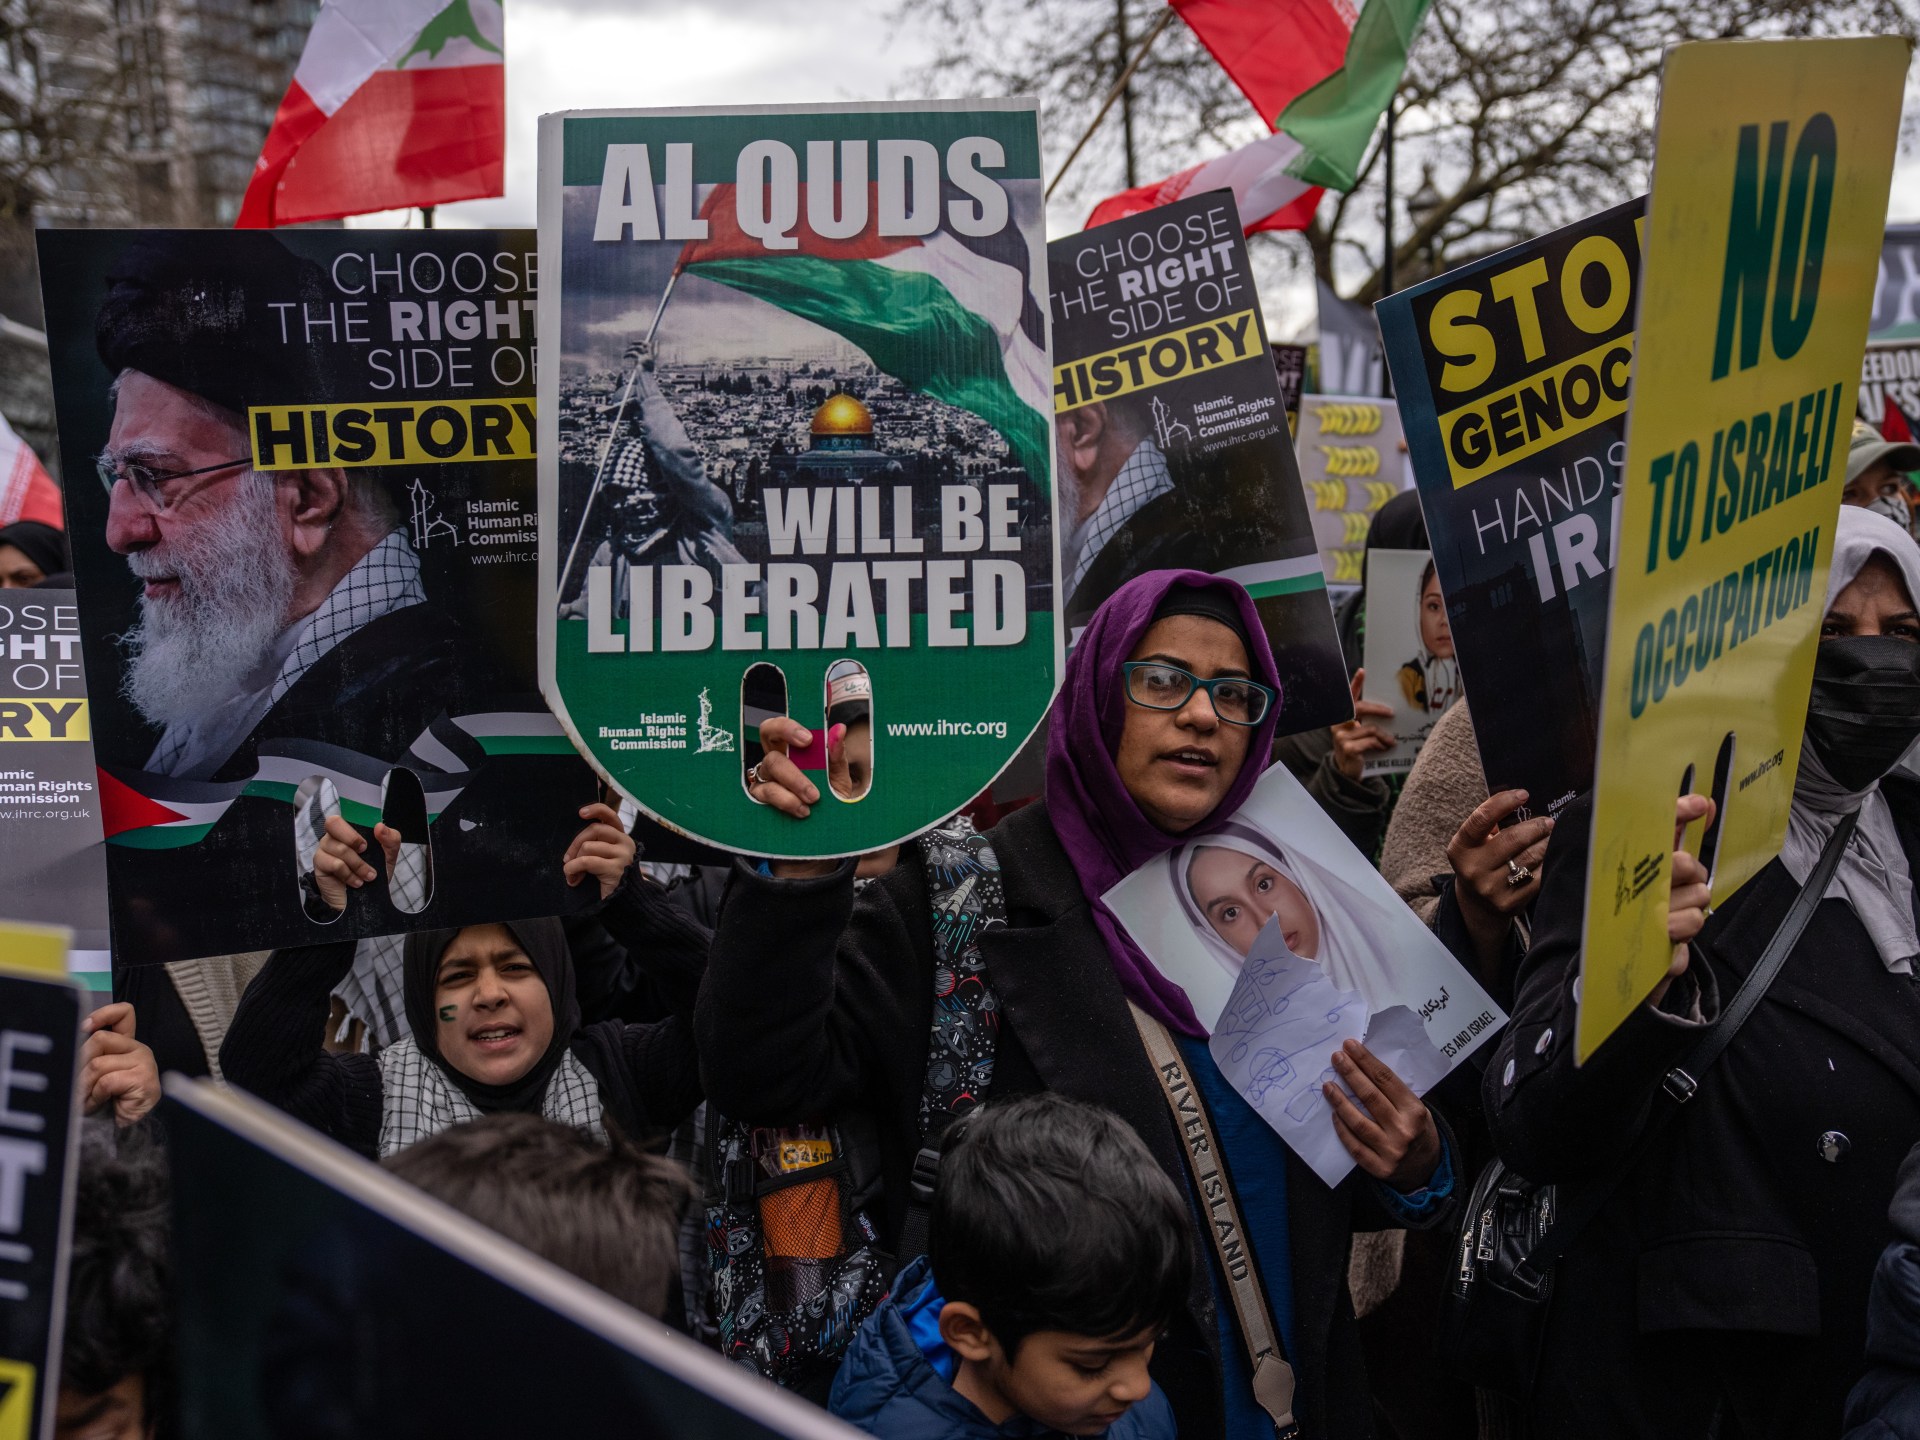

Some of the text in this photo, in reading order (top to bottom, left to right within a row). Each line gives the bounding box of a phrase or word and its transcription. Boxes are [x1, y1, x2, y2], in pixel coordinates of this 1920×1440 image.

[593, 136, 1008, 250] AL QUDS
[1076, 206, 1230, 278] CHOOSE
[1711, 112, 1837, 382] NO
[1118, 239, 1235, 302] RIGHT
[268, 302, 370, 343] THE
[1108, 273, 1243, 339] SIDE OF
[1429, 215, 1648, 393] STO
[369, 348, 472, 390] SIDE
[1054, 313, 1251, 409] HISTORY
[1193, 395, 1234, 414] Islamic
[1196, 397, 1276, 426] Human Rights
[1450, 347, 1632, 470] GENOC
[1199, 411, 1269, 437] Commission
[1203, 424, 1280, 452] www.ihrc.org.uk
[1645, 382, 1843, 576] TO ISRAELI
[466, 499, 519, 514] Islamic
[468, 513, 538, 530] Human Ri
[763, 484, 1021, 555] WILL BE
[469, 530, 538, 545] Commiss
[1528, 495, 1622, 604] IR
[471, 551, 538, 565] www.ihrc.o
[587, 559, 1027, 654] LIBERATED
[1629, 526, 1819, 720] OCCUPATION
[13, 664, 80, 690] OF
[0, 702, 83, 738] RY
[599, 725, 687, 739] Human Rights
[640, 713, 686, 724] Islamic
[887, 720, 1007, 738] www.ihrc.org
[611, 738, 687, 750] Commission
[0, 781, 93, 792] man Rights
[1739, 749, 1784, 792] www.ihrc.org
[0, 793, 80, 804] mmission
[0, 808, 91, 820] w.ihrc.org.uk
[1547, 789, 1577, 812] Islamic
[1453, 1030, 1471, 1050] AND
[1467, 1010, 1497, 1037] ISRAEL
[1160, 1061, 1249, 1282] RIVER ISLAND
